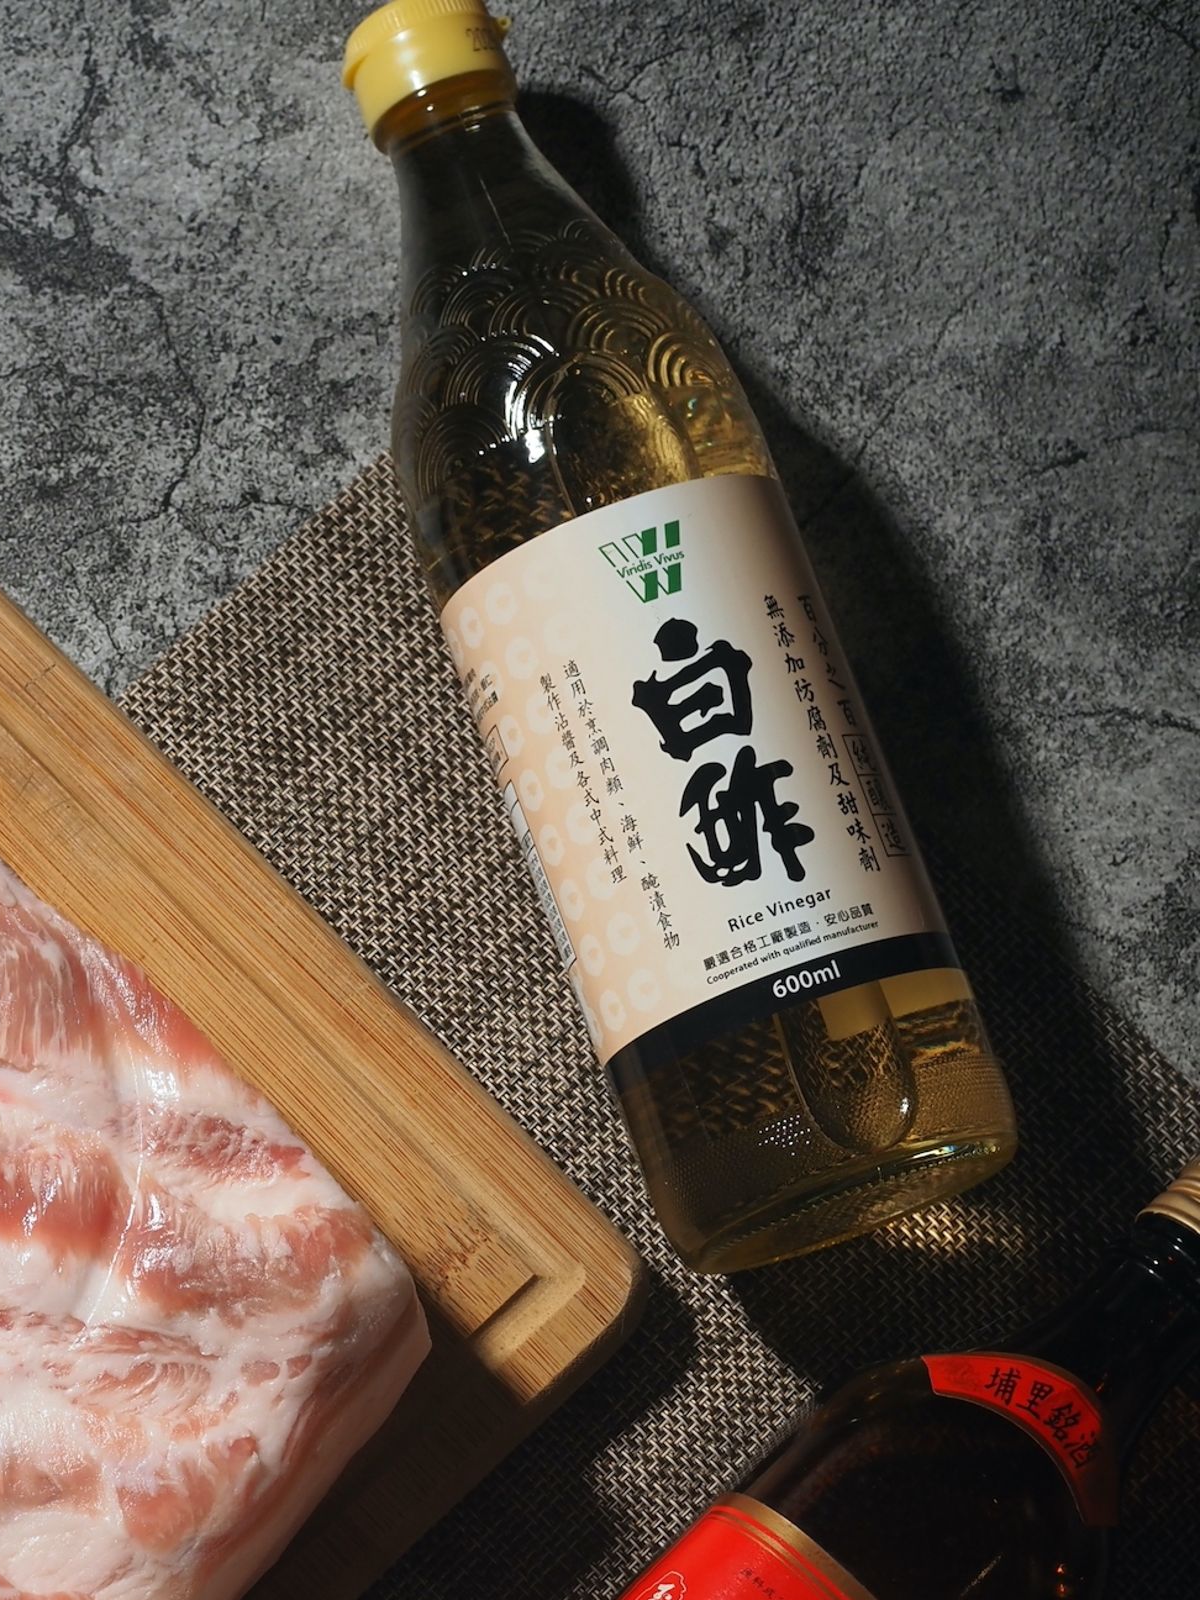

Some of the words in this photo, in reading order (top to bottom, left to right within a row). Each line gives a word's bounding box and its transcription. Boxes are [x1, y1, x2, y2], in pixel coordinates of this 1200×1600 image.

[616, 560, 653, 578] Viridis
[654, 550, 685, 565] Vivus
[632, 618, 815, 887] 白酢
[764, 594, 881, 873] 無添加防腐劑及甜味劑
[727, 912, 764, 933] Rice
[766, 888, 832, 918] Vinegar
[706, 957, 759, 985] Cooperated
[760, 950, 781, 964] with
[782, 935, 822, 956] qualified
[822, 920, 879, 942] manufacturer
[772, 959, 841, 998] 600ml
[983, 1367, 1098, 1470] 埔里銘酒
